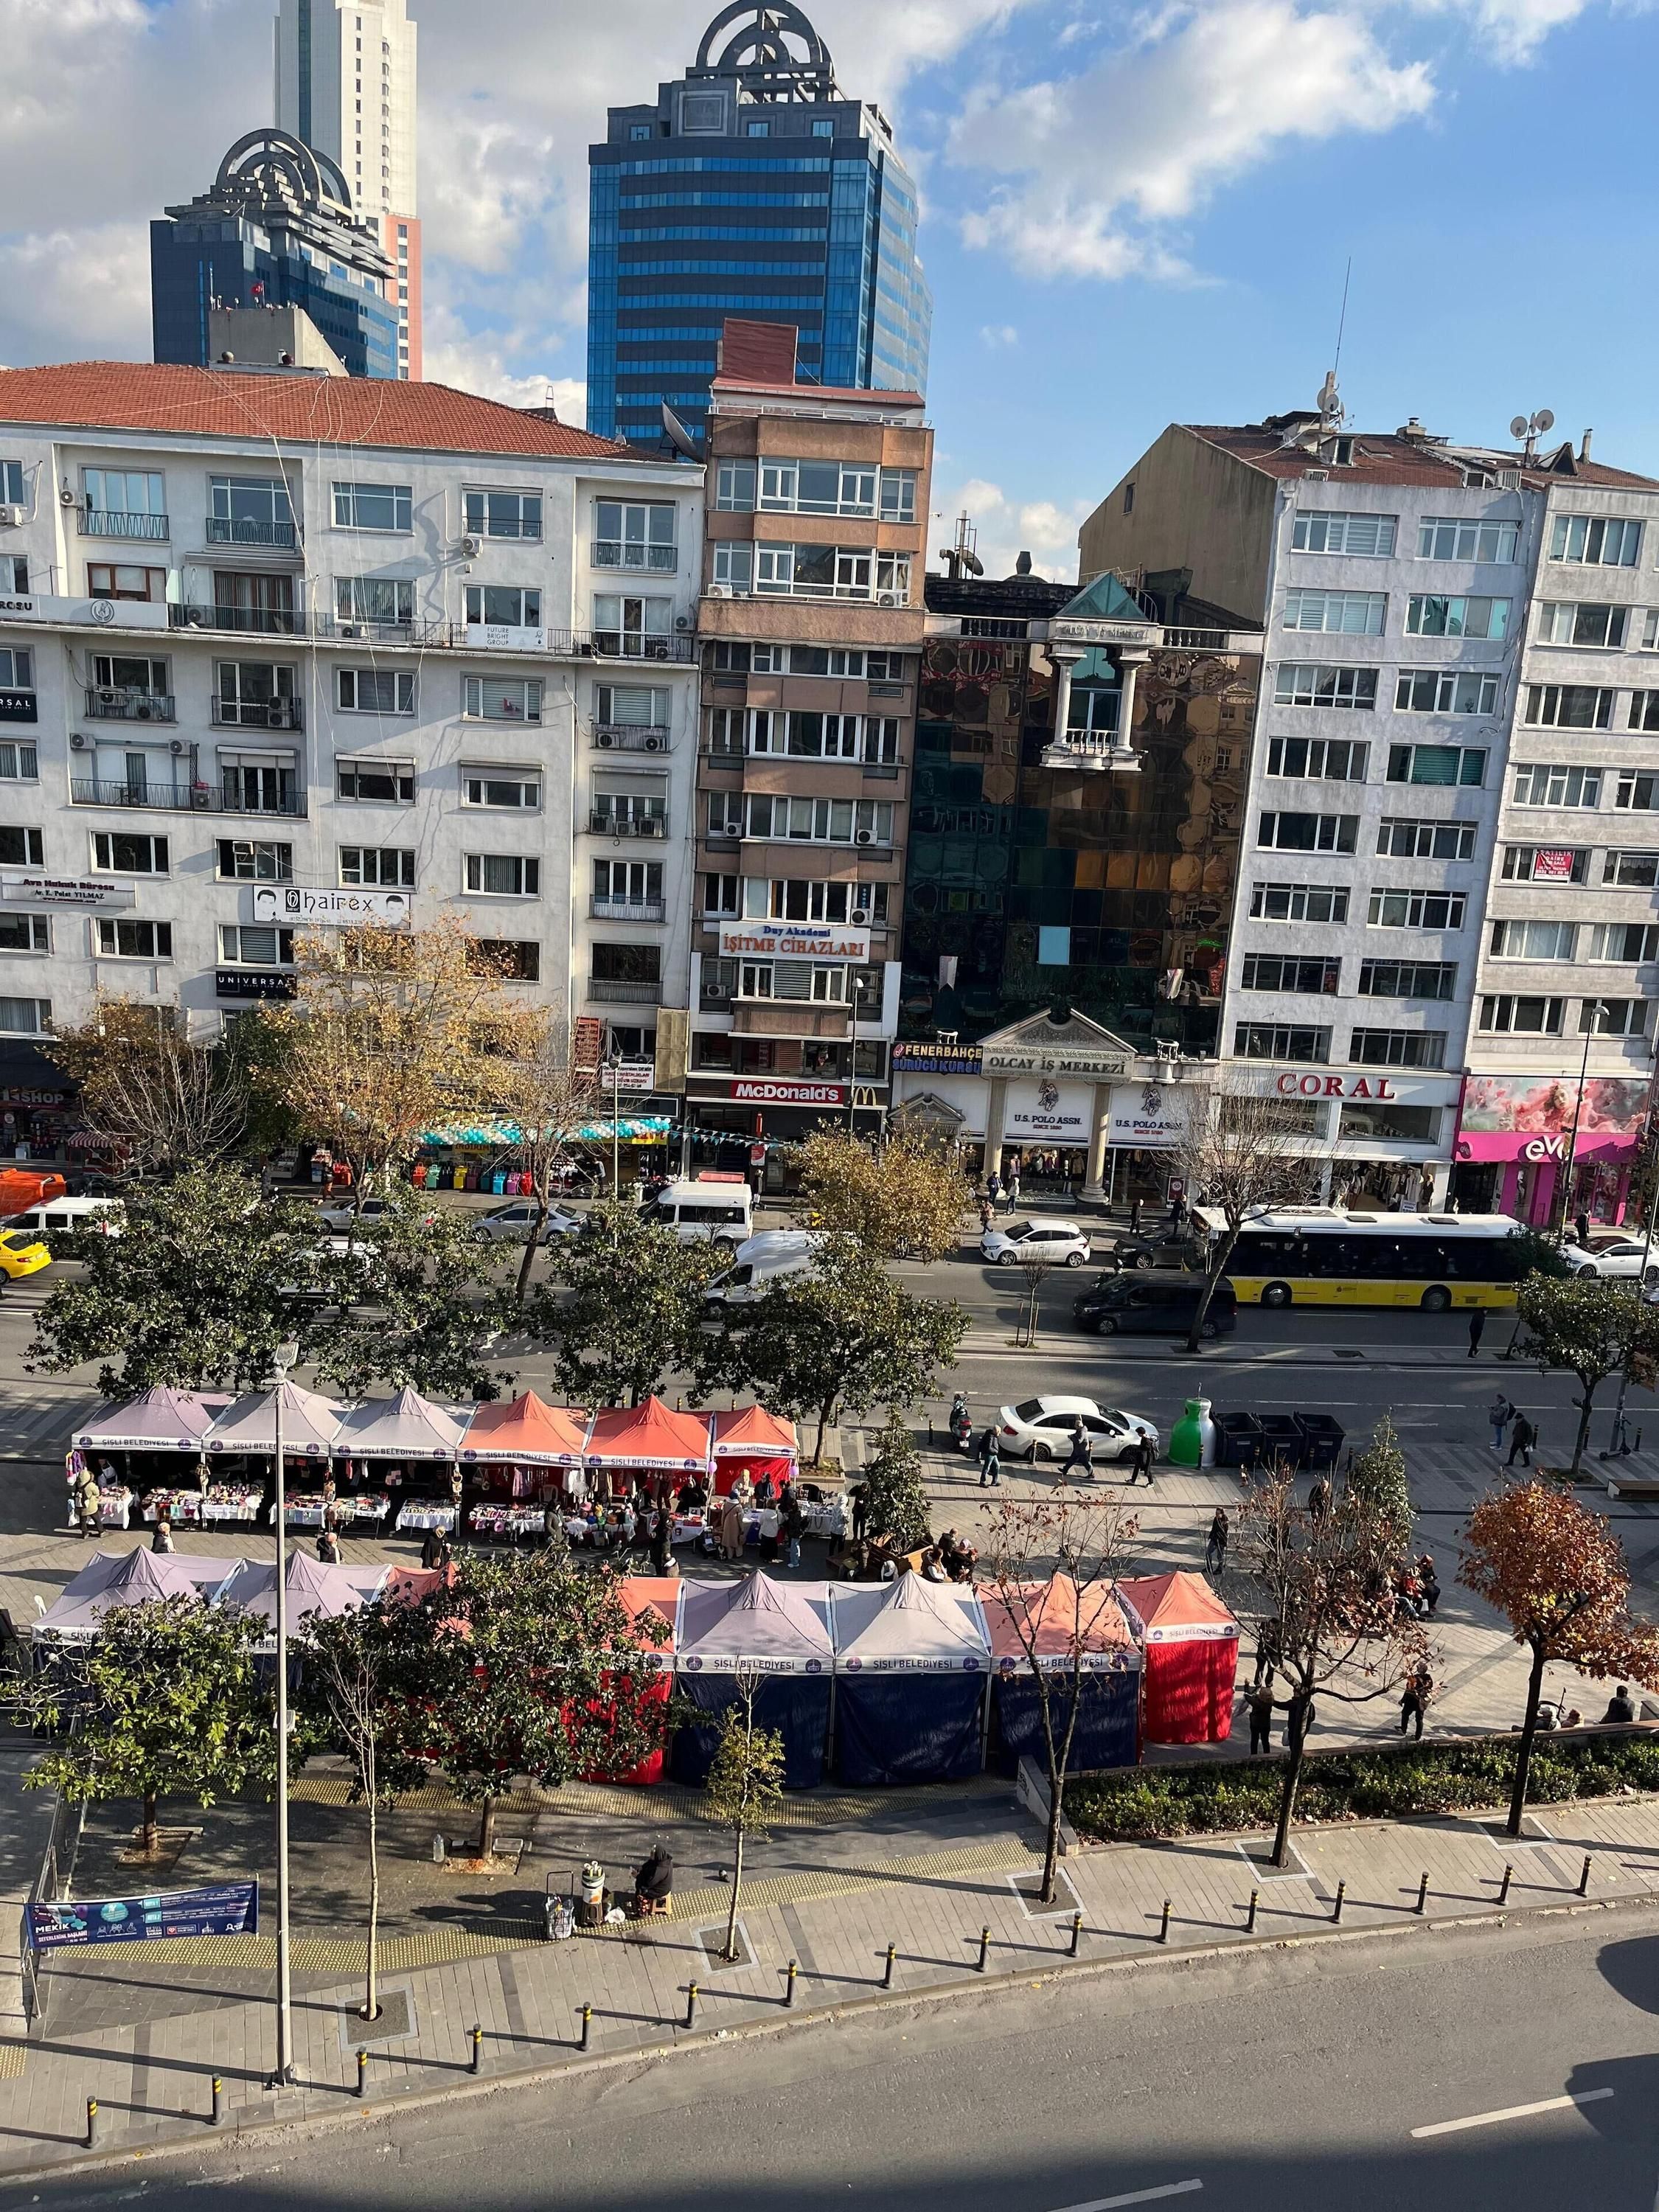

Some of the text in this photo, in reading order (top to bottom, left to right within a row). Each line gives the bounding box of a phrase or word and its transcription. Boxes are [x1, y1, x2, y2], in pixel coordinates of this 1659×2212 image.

[74, 891, 105, 900] YILMAZ
[305, 892, 372, 914] hairex
[763, 925, 831, 937] Duy Akademi
[723, 933, 864, 956] İŞİTME CİHAZLARI
[218, 976, 288, 986] UNIVERSA
[905, 1045, 982, 1060] FENERBAHÇE
[892, 1056, 981, 1074] SÜRÜCÜ KURSU
[990, 1057, 1126, 1074] OLCAY İŞ MERKEZİ
[736, 1083, 839, 1101] McDonald's
[1277, 1073, 1396, 1099] CORAL
[1015, 1114, 1030, 1122] U.S.
[1032, 1115, 1055, 1124] POLO
[254, 1443, 298, 1452] BELEDESİ
[1051, 1658, 1103, 1669] BELEİYESİ
